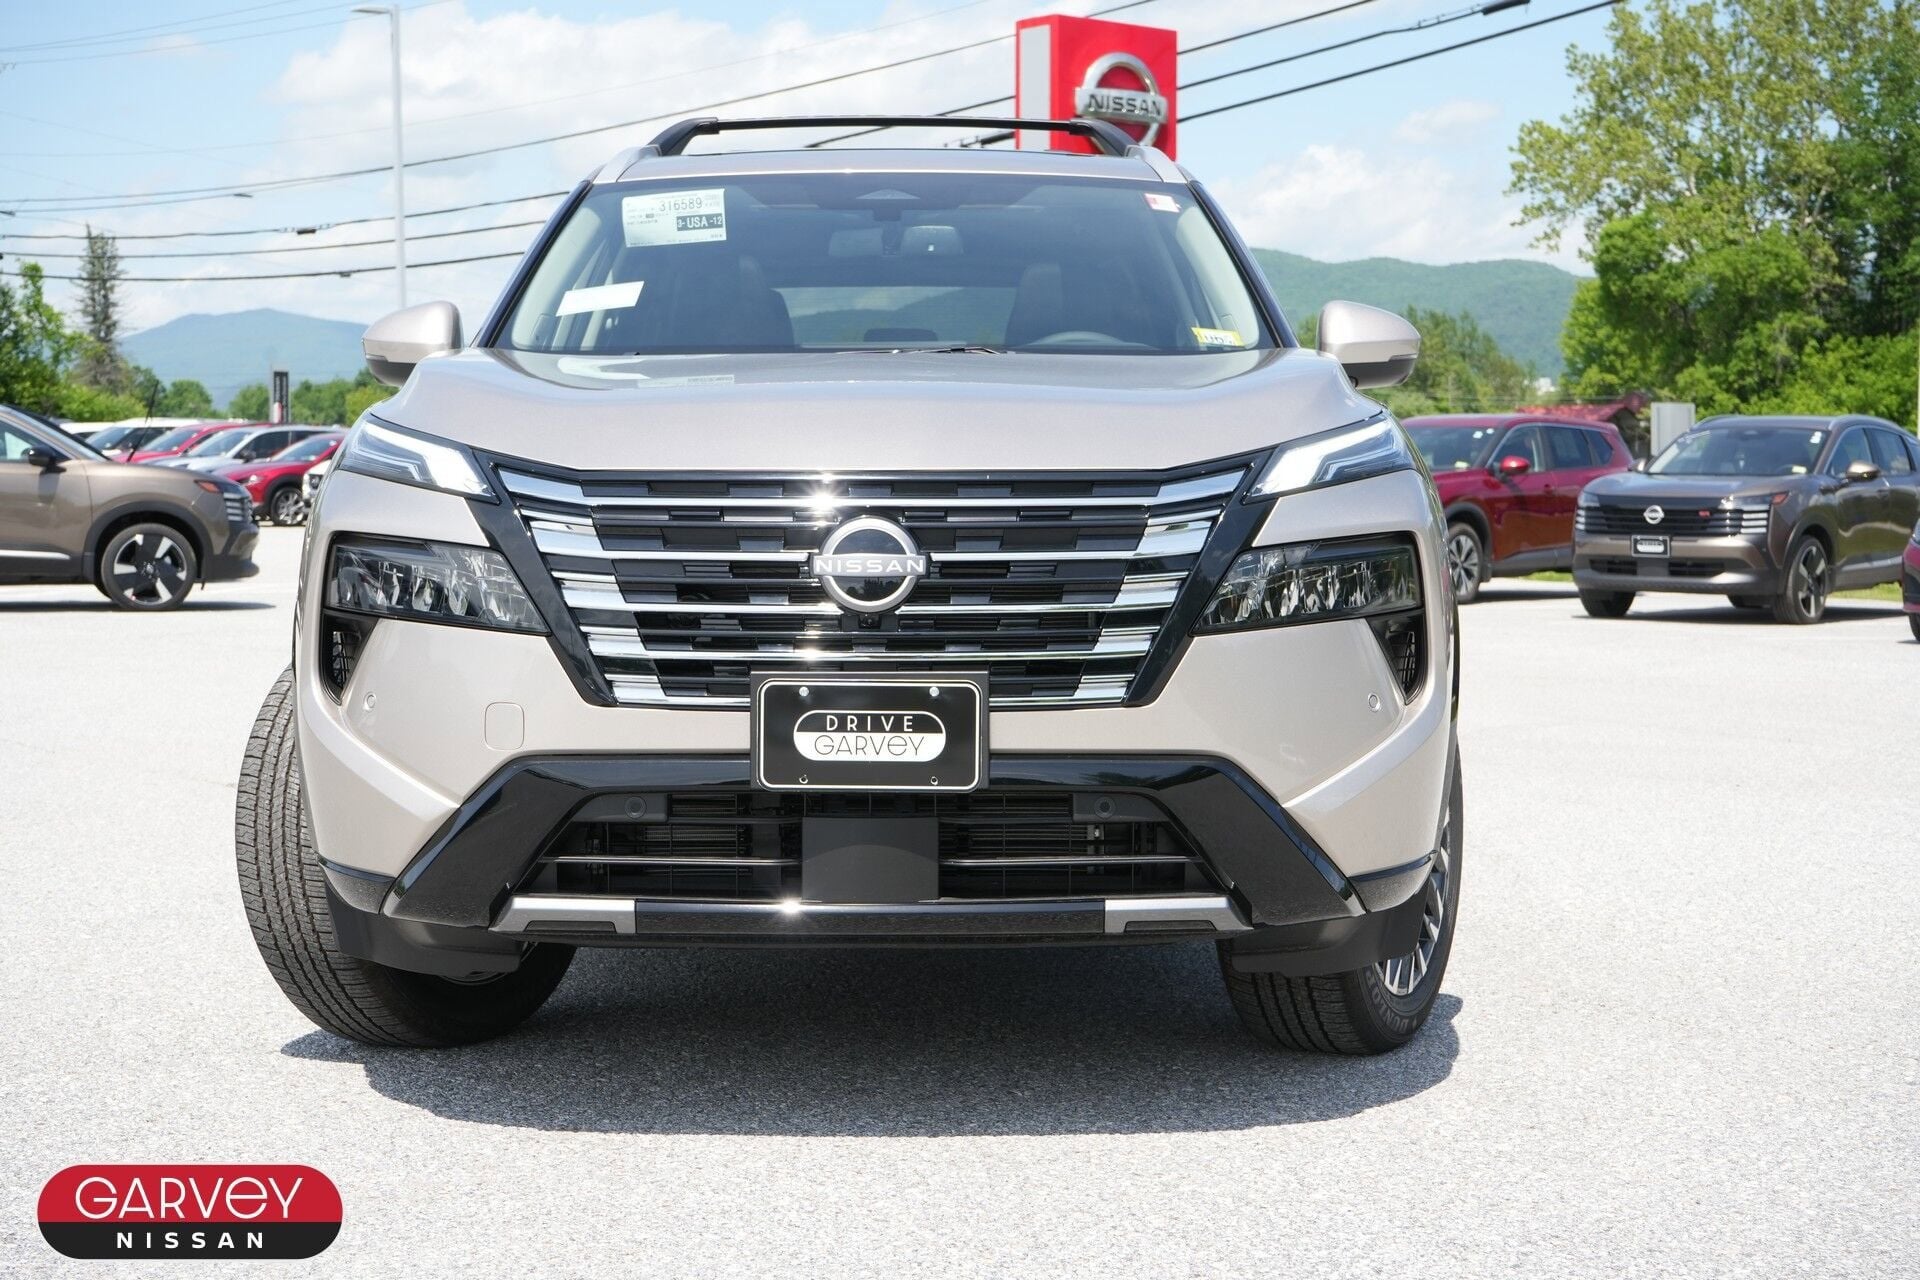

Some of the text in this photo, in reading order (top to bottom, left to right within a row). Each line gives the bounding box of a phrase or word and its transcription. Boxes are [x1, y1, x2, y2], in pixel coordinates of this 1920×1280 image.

[1088, 94, 1161, 116] NISSAN
[659, 197, 703, 212] 316589
[687, 215, 708, 228] USA
[815, 559, 924, 573] NISSAN
[826, 715, 913, 731] DRIVE
[1365, 970, 1410, 1034] DUNLOP
